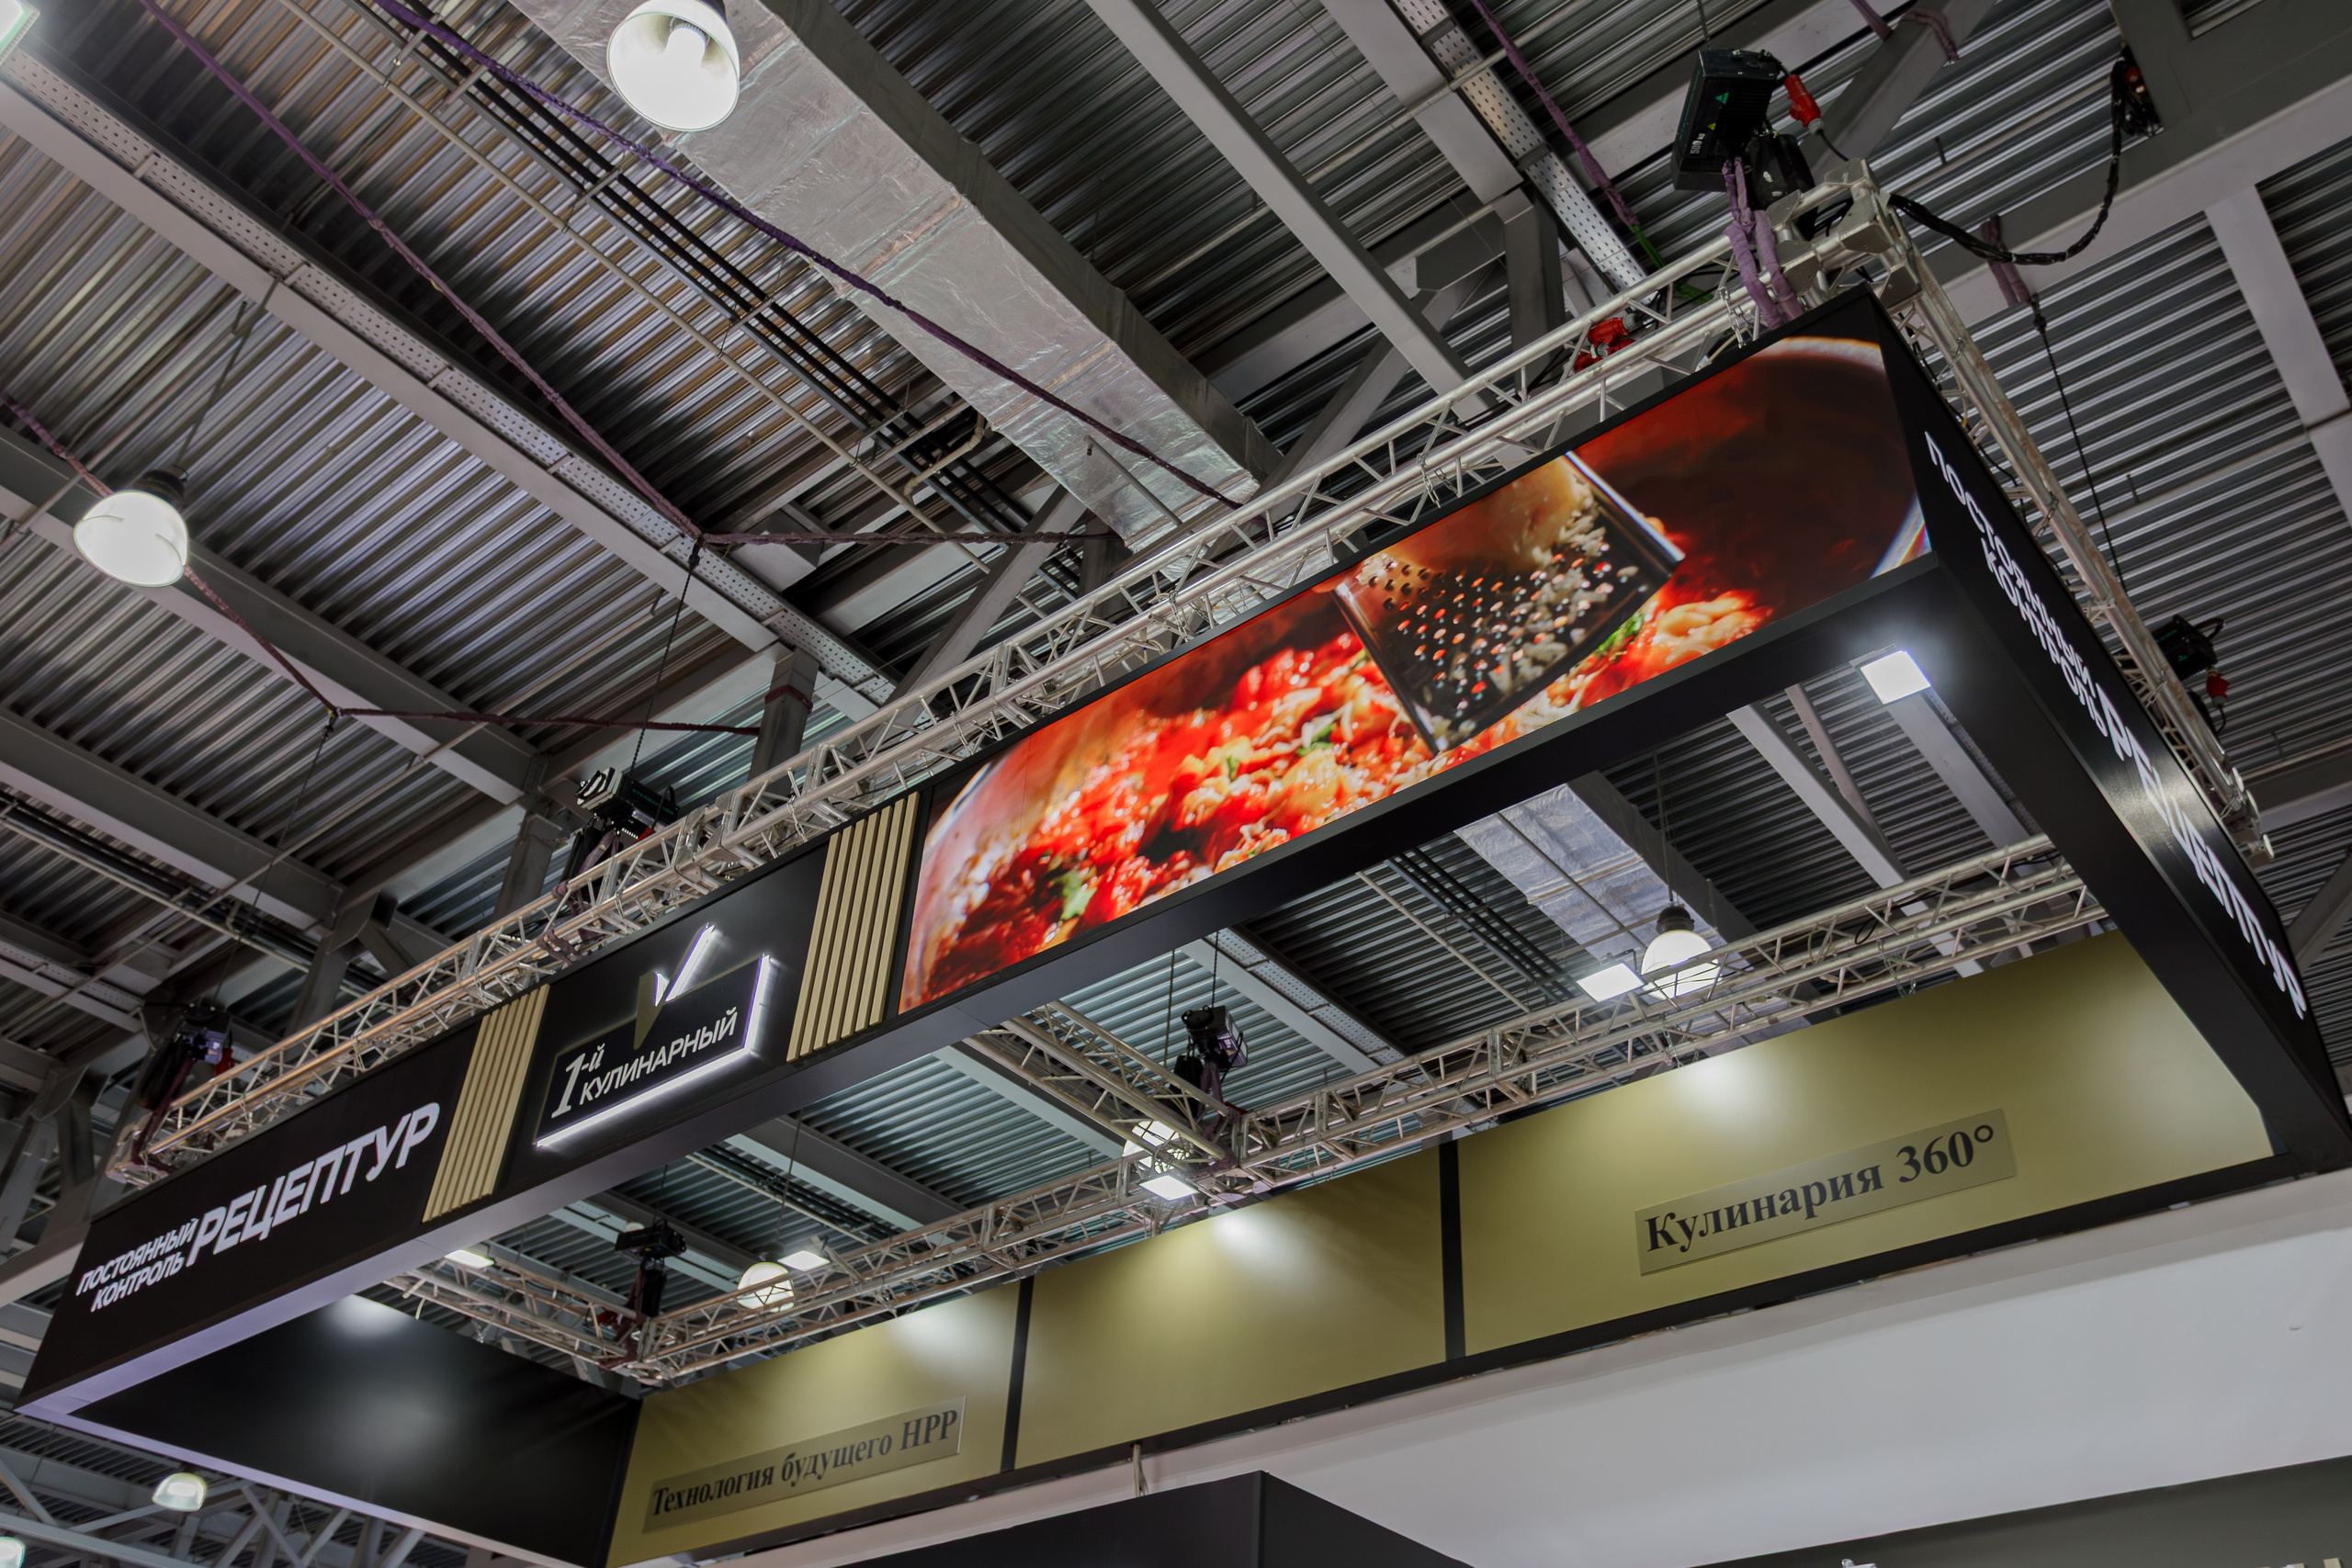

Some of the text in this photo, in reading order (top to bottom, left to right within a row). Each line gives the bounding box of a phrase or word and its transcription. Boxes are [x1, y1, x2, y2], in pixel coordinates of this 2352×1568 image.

[1924, 431, 2097, 699] ПОСТОЯННЫЙ
[1981, 537, 2108, 737] КОНТРОЛЬ
[2095, 682, 2307, 1021] РЕЦЕПТУР
[551, 1043, 605, 1119] 1-й
[579, 1007, 738, 1105] КУЛИНАРНЫЙ
[186, 1102, 440, 1267] РЕЦЕПТУР
[1644, 1124, 1994, 1253] Кулинария 360°
[75, 1218, 199, 1296] ПОСТОЯННЫЙ
[90, 1256, 186, 1312] КОНТРОЛЬ
[652, 1465, 775, 1516] Технология
[781, 1434, 892, 1487] будущего
